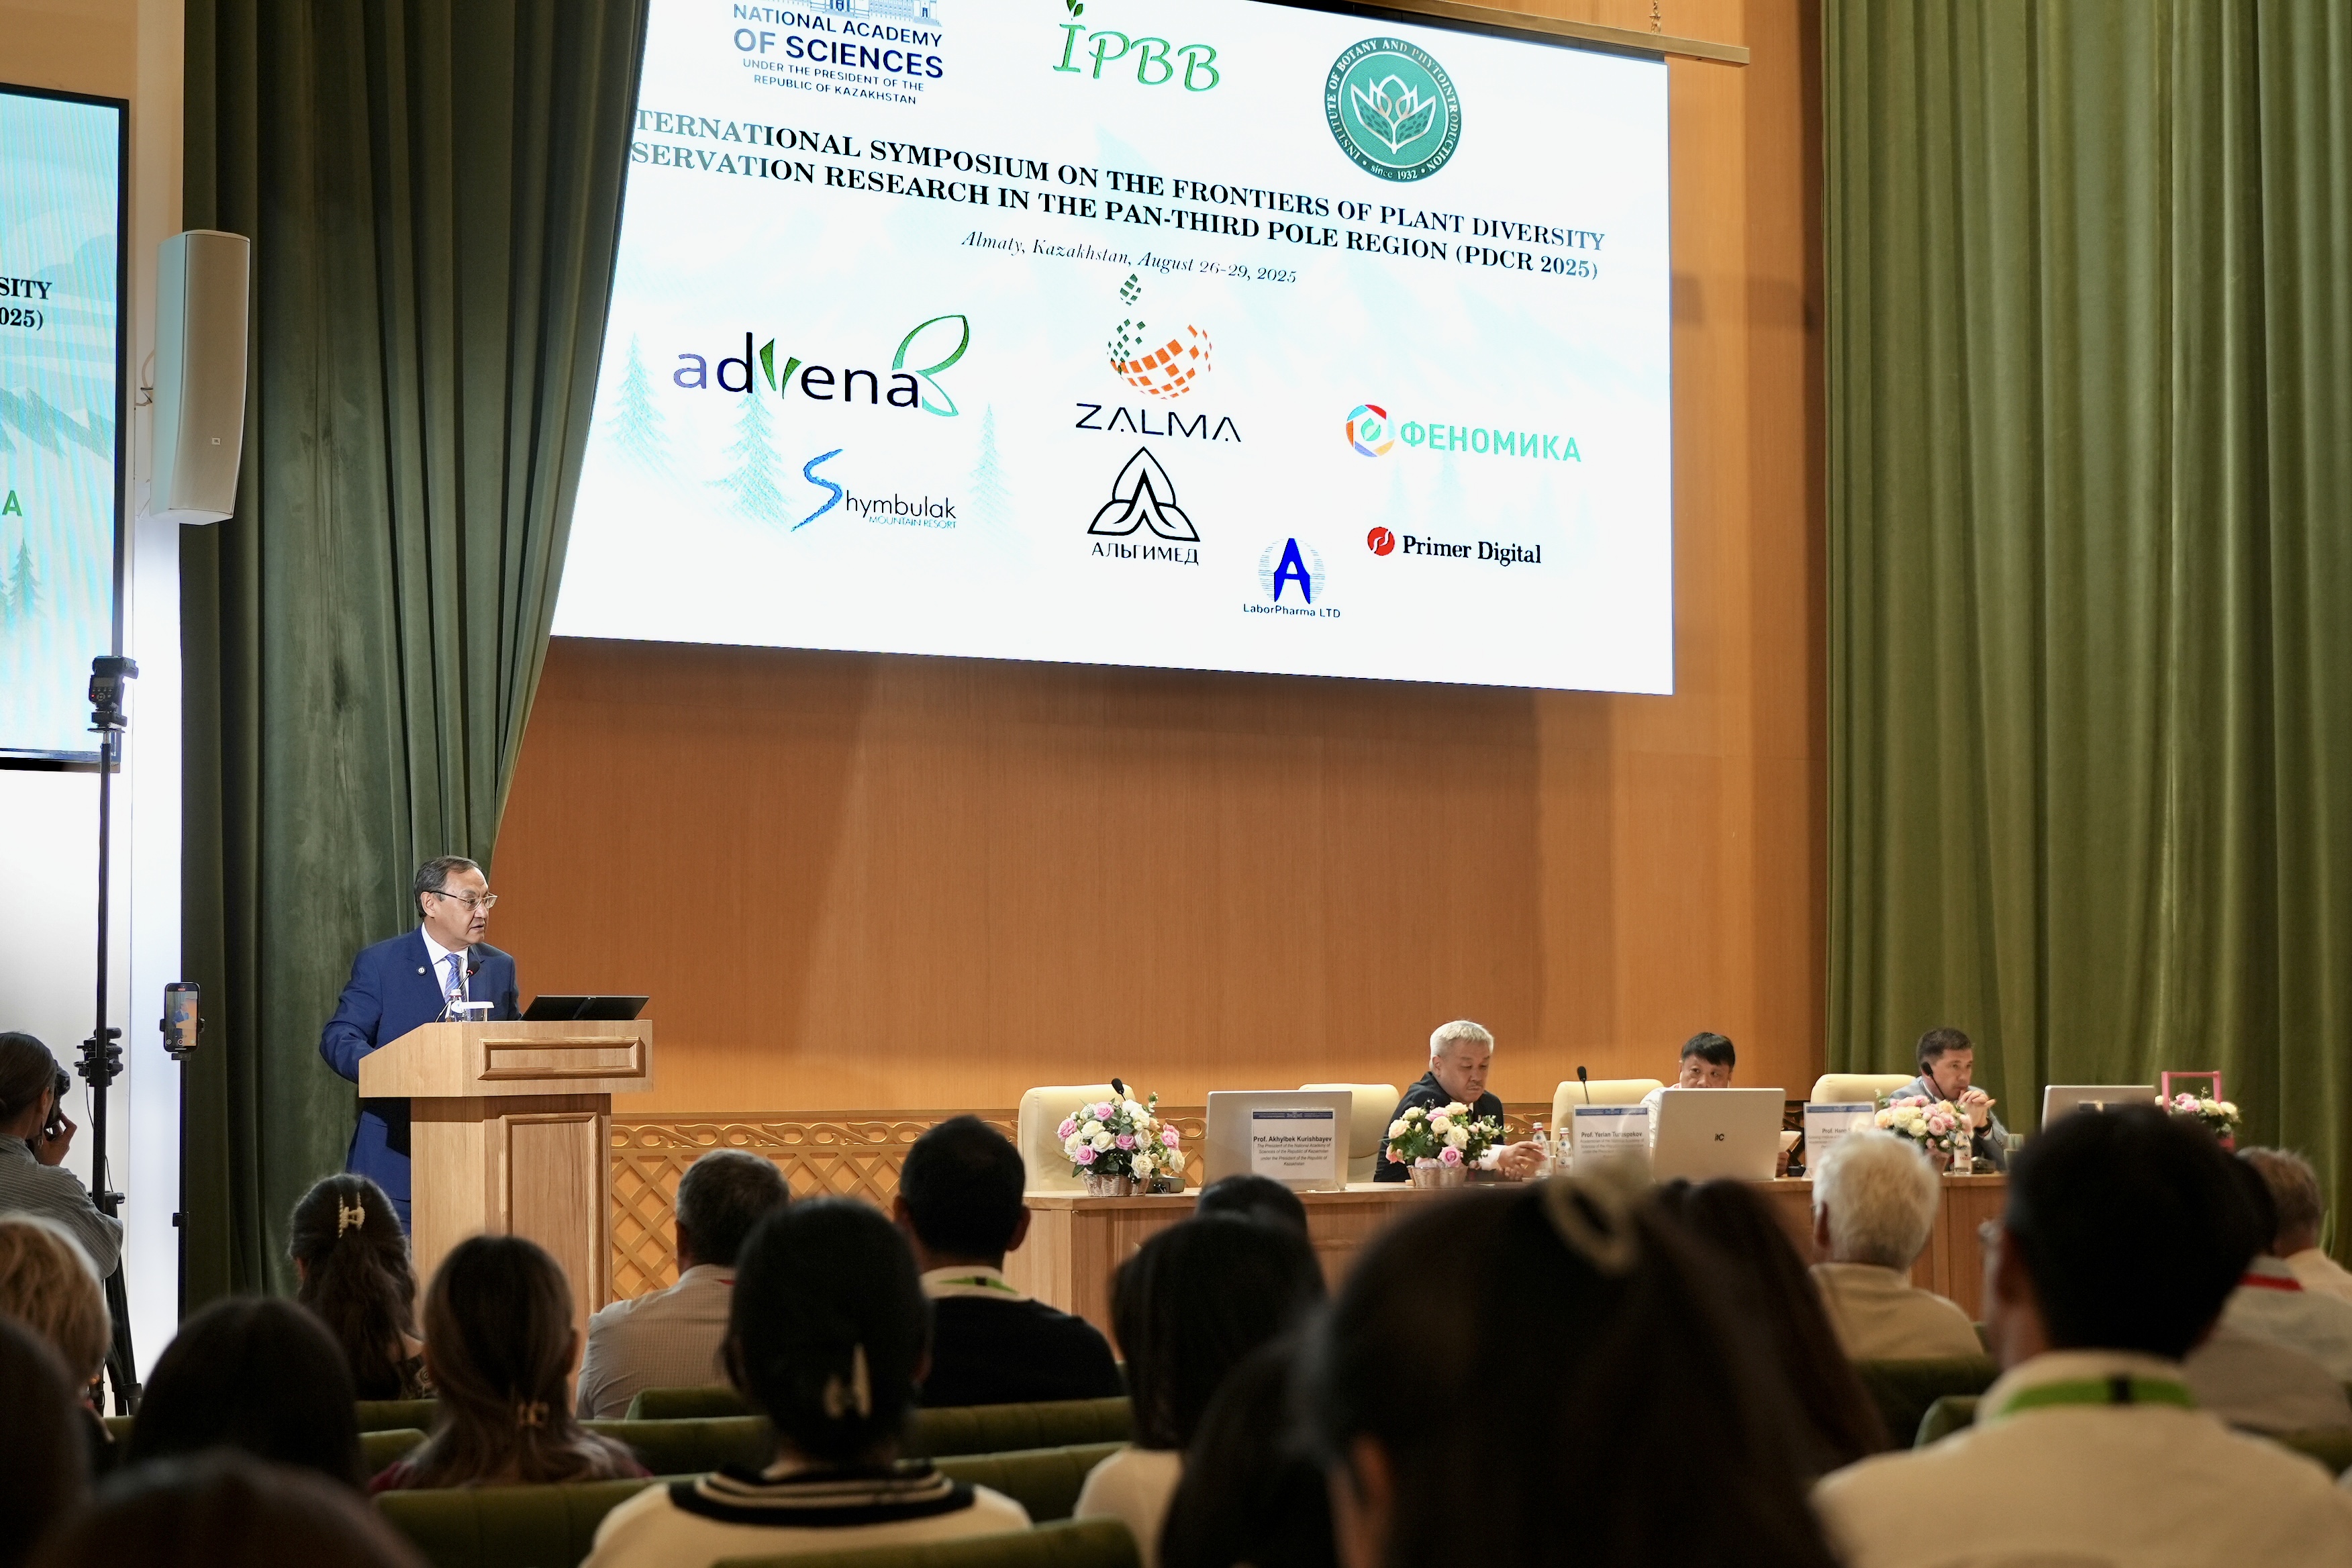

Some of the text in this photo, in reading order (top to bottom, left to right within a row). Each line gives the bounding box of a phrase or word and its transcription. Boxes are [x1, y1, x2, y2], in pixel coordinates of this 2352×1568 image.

[734, 4, 942, 48] NATIONAL ACADEMY
[734, 28, 944, 79] OF SCIENCES
[743, 58, 924, 92] UNDER THE PRESIDENT OF THE
[754, 75, 916, 105] REPUBLIC OF KAZAKHSTAN
[1326, 39, 1459, 171] INSTITUTE OF BOTANY AND PHYTOINTRODUCTION
[1370, 164, 1418, 180] since 1932
[871, 140, 1048, 181] SYMPOSIUM
[1058, 165, 1098, 188] ON
[1107, 170, 1165, 196] THE
[1173, 179, 1329, 217] FRONTIERS
[1338, 201, 1372, 222] OF
[1379, 205, 1465, 234] PLANT
[1473, 218, 1606, 252] DIVERSITY
[824, 166, 989, 206] RESEARCH
[997, 188, 1030, 209] IN
[1038, 193, 1097, 218] THE
[1105, 202, 1259, 238] PAN-THIRD
[1267, 222, 1338, 247] POLE
[1346, 231, 1447, 261] REGION
[1456, 245, 1534, 271] (PDCR
[1540, 256, 1598, 281] 2025)
[962, 232, 1297, 283] Almaty, Kazakhstan, August 26-29, 2025
[1075, 403, 1241, 442] ZALMA
[1400, 421, 1581, 462] ФЕНОМИКА
[791, 449, 957, 532] Shymbulak
[869, 516, 957, 530] MOUNTAIN RESORT
[1091, 542, 1199, 566] АЛЬГИМЕД
[1403, 535, 1541, 567] Primer Digital
[1243, 603, 1340, 618] LaborPharma LTD
